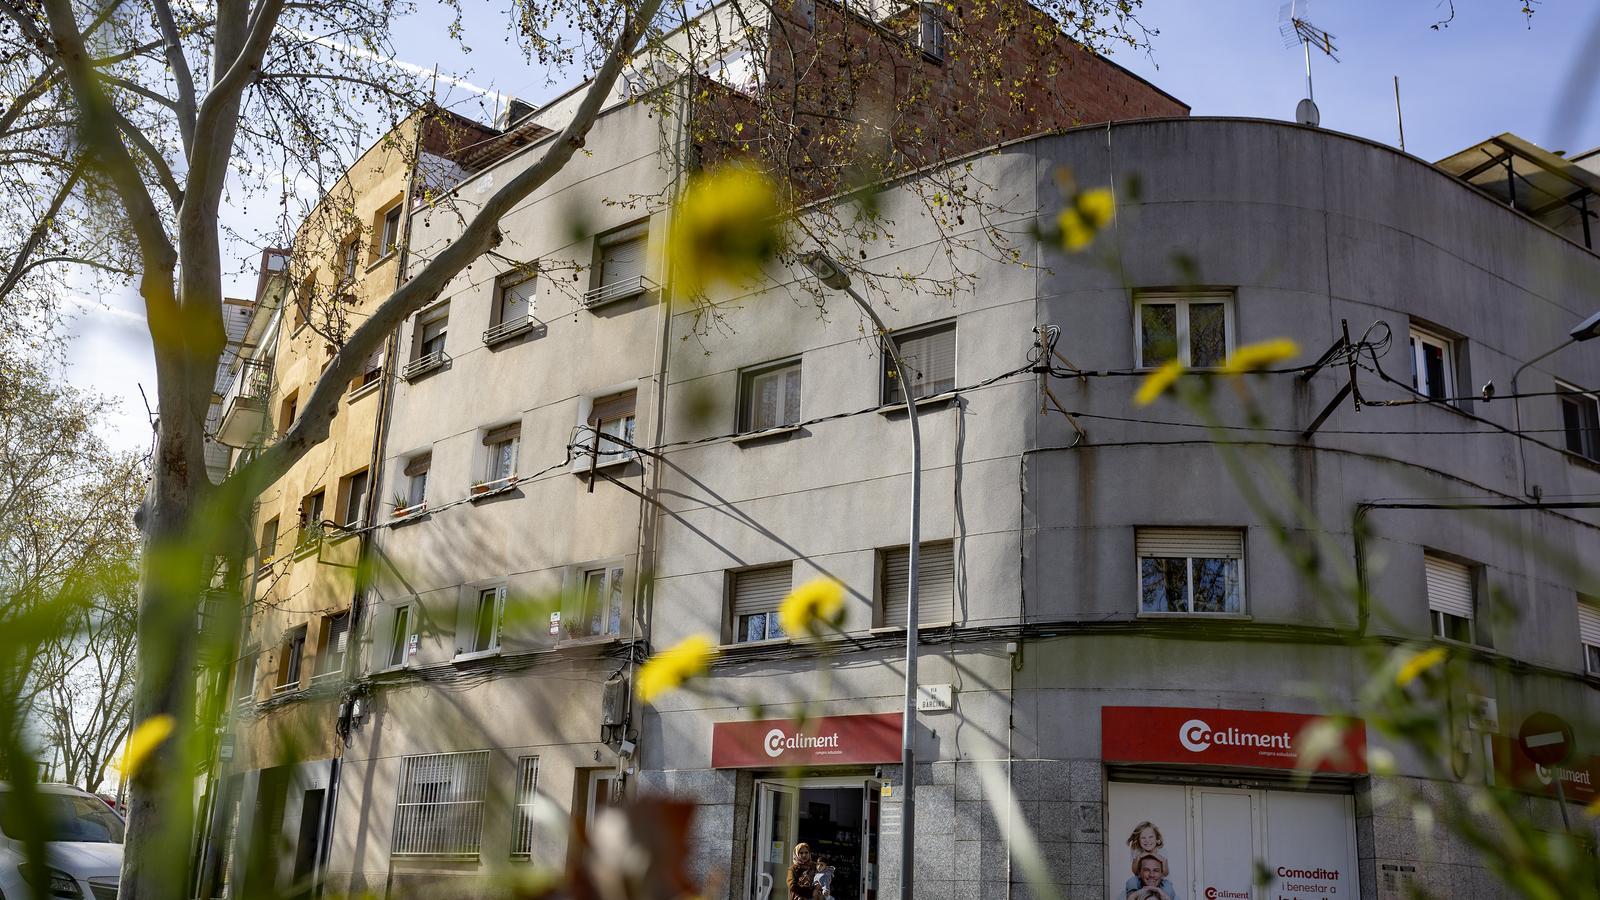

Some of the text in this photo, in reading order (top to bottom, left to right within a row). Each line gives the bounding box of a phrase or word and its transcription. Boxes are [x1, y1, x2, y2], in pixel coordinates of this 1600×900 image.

[1277, 866, 1340, 881] Comoditat
[1287, 882, 1328, 893] benestar
[1329, 886, 1337, 894] a
